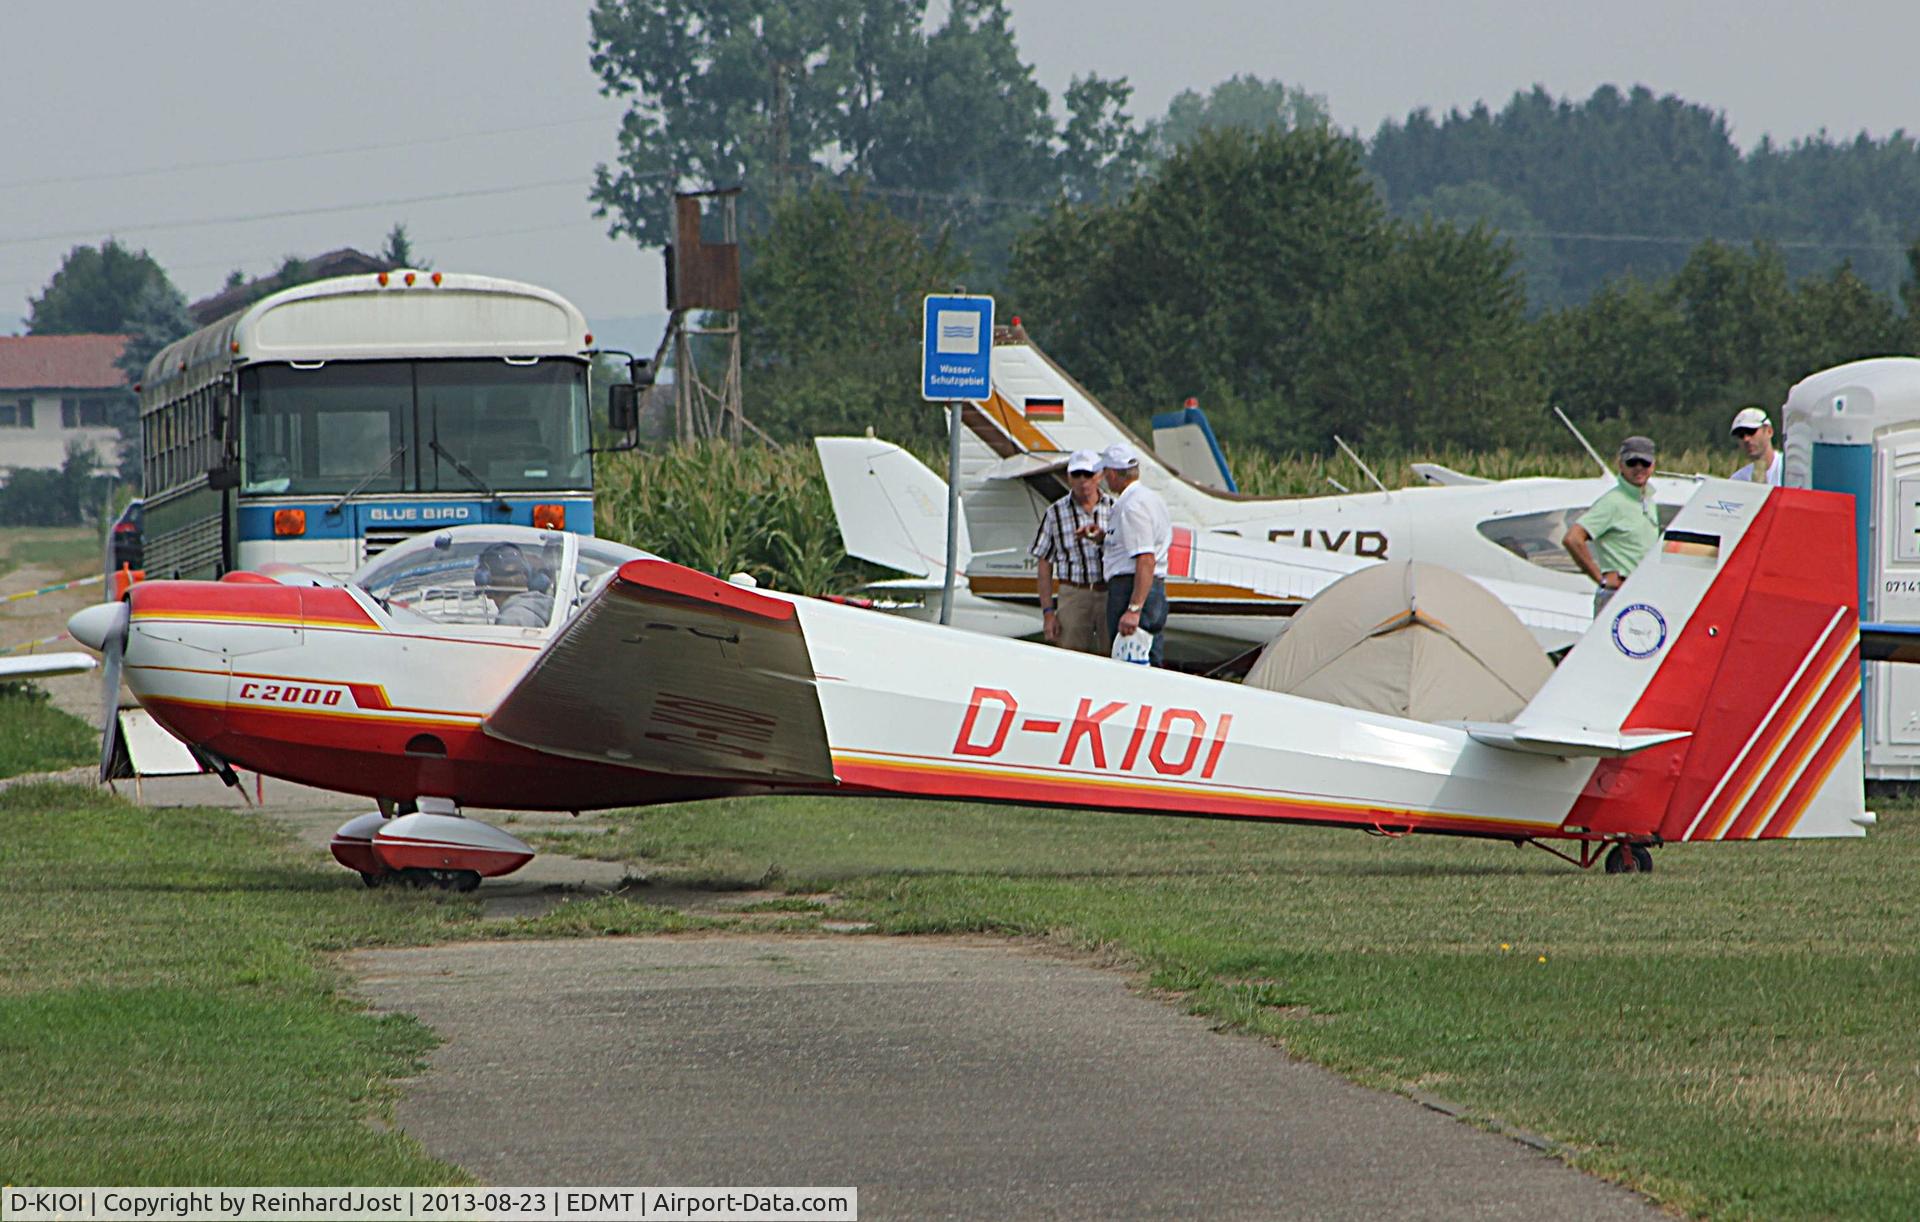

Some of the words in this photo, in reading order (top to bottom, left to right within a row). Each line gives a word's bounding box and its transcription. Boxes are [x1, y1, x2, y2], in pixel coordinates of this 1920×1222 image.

[940, 364, 976, 374] Wasser-
[930, 374, 985, 387] Schutzgebiet
[371, 507, 417, 520] BLUE
[423, 506, 469, 519] BIRD
[240, 683, 342, 706] C2000
[952, 686, 1233, 779] D-KIOI
